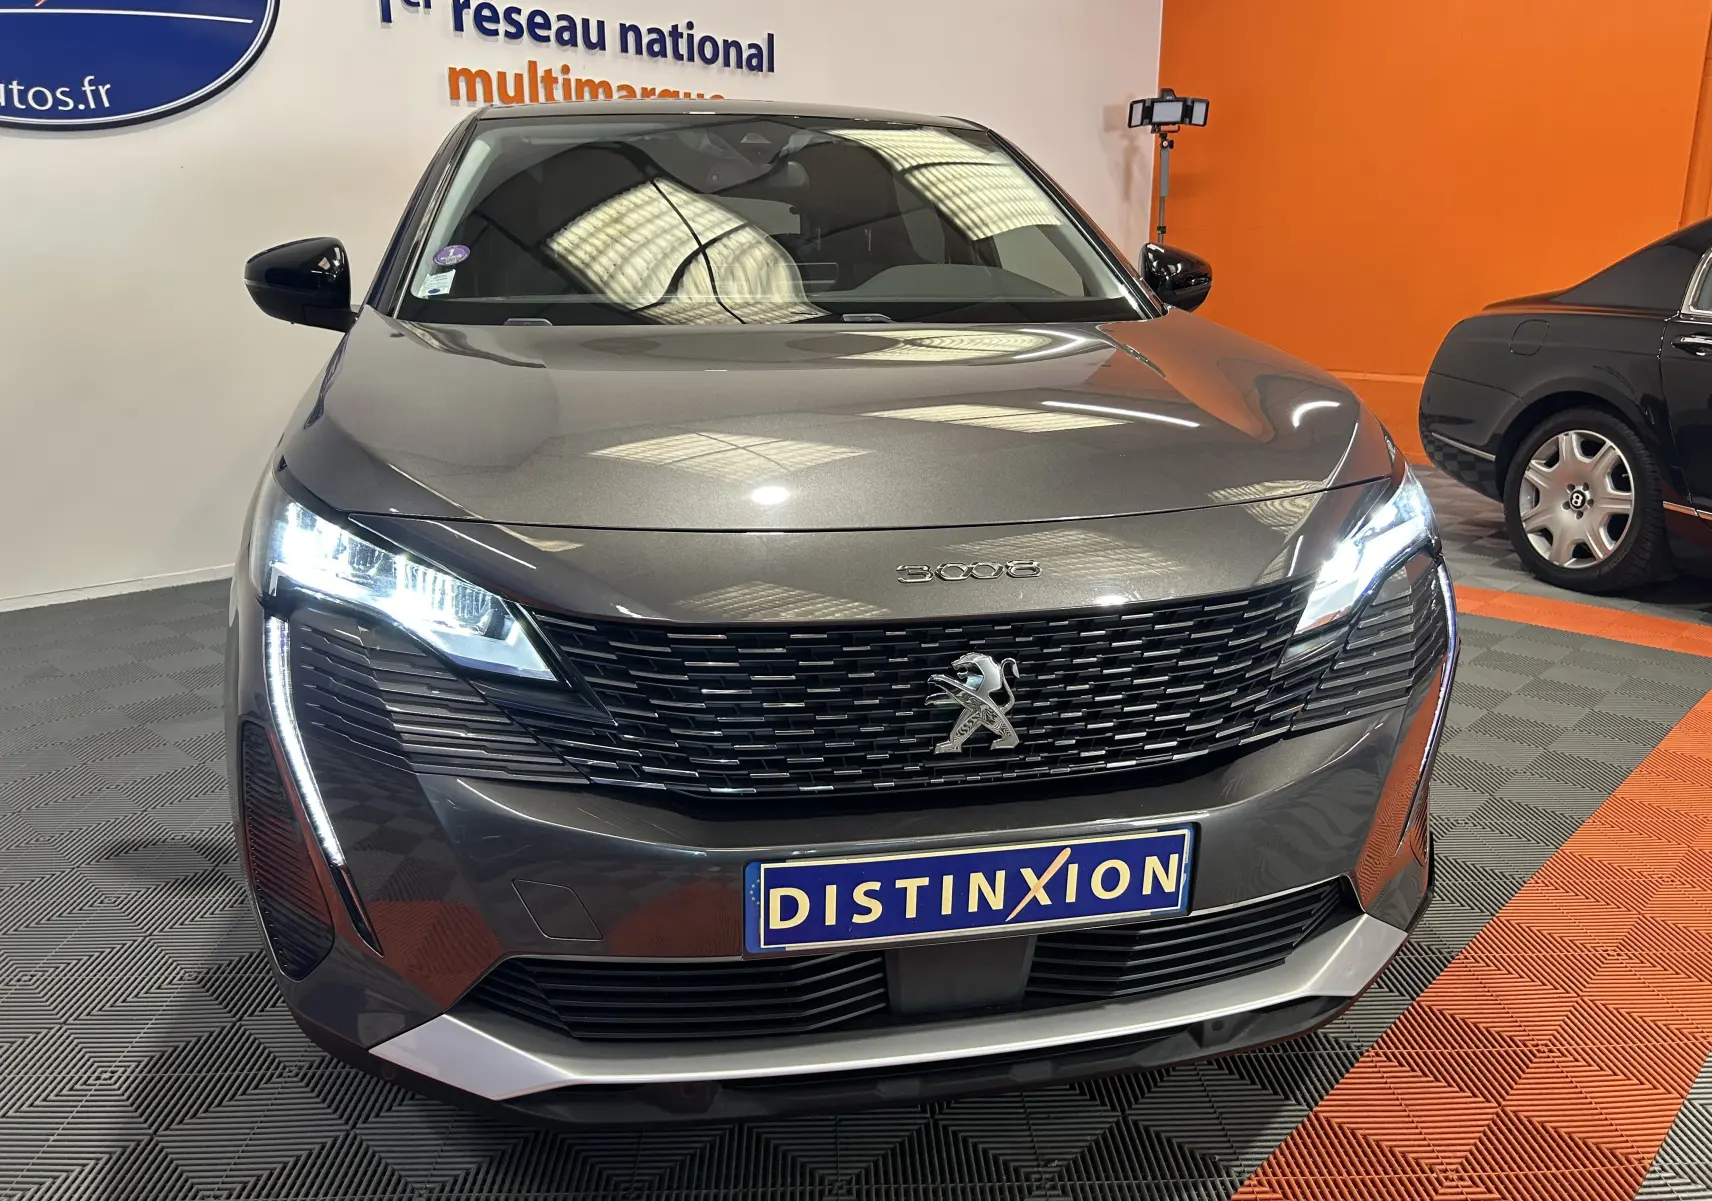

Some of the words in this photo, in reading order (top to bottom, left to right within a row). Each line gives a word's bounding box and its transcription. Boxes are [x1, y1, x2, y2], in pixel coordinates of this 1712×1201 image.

[619, 20, 775, 73] national
[896, 560, 1043, 584] 3008
[768, 847, 1179, 930] DISTINXION
